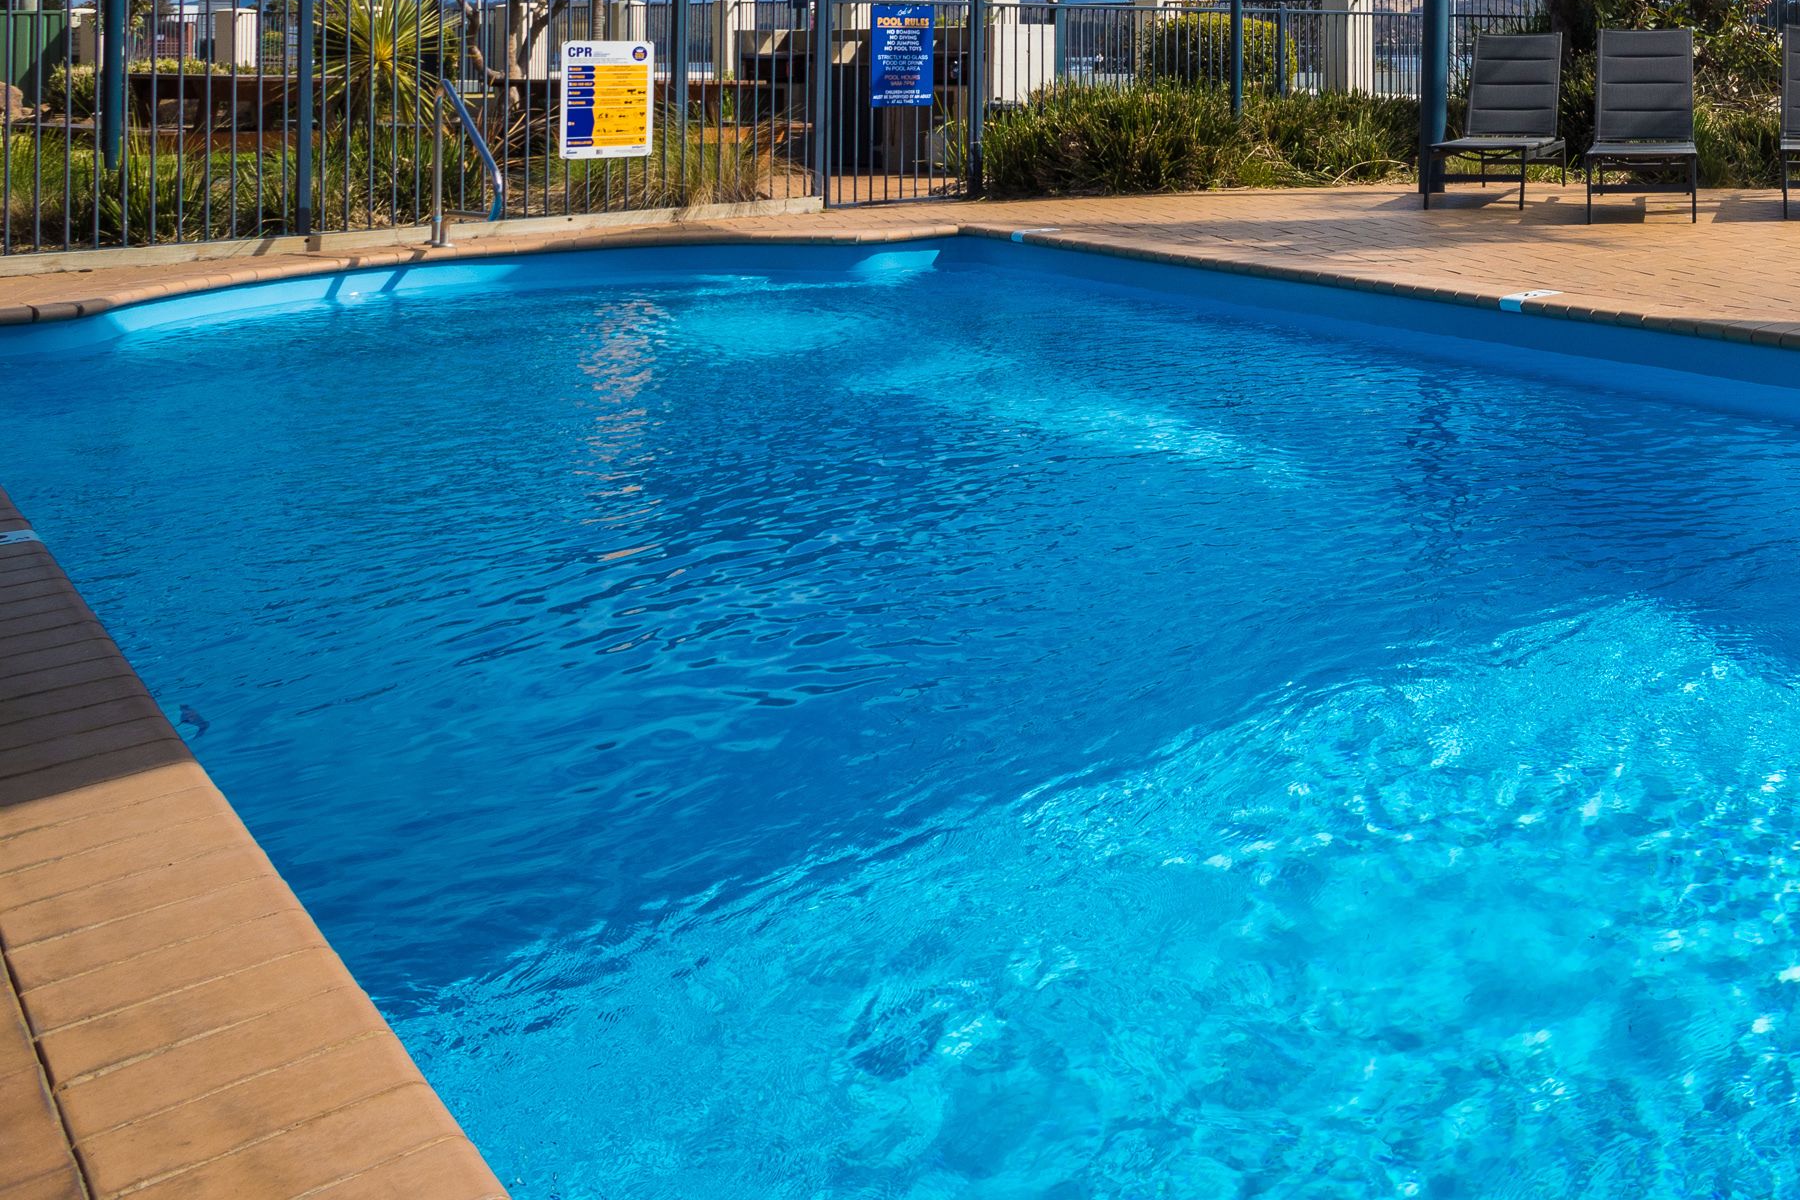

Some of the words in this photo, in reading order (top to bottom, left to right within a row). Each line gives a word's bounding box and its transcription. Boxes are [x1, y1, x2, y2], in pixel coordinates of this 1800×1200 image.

[877, 17, 902, 26] POOL
[905, 18, 929, 26] RULES
[568, 47, 592, 57] CPR
